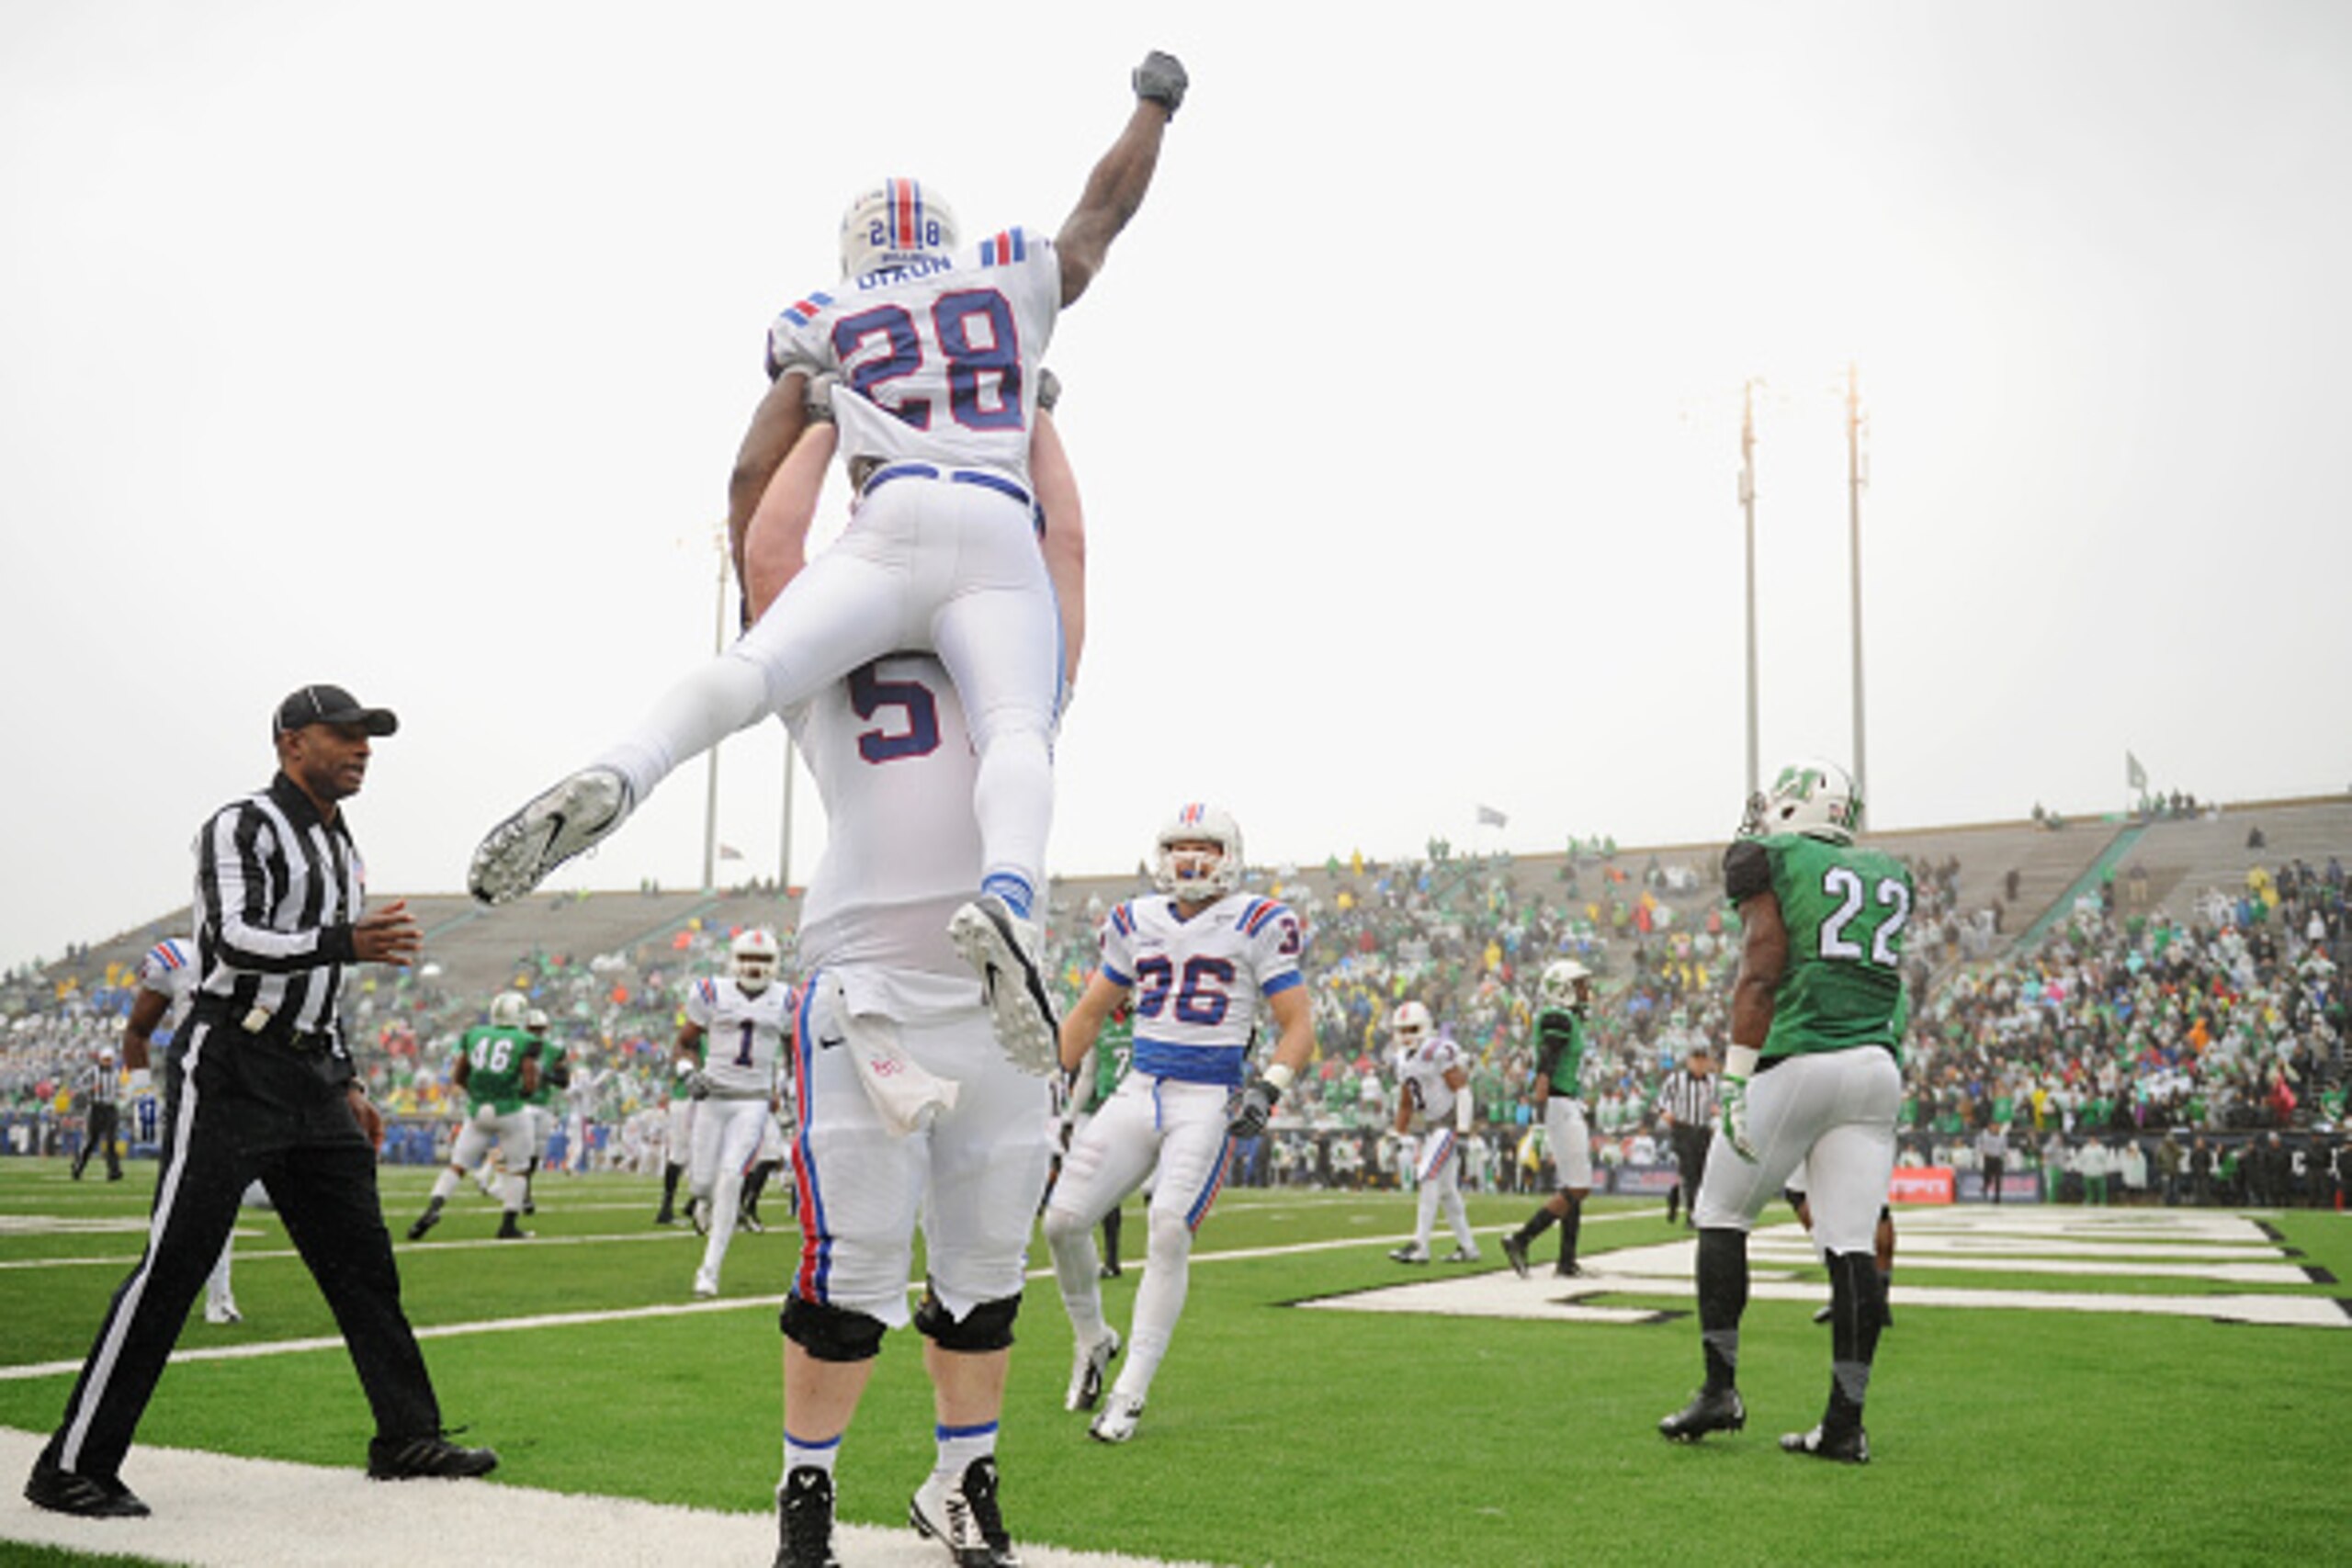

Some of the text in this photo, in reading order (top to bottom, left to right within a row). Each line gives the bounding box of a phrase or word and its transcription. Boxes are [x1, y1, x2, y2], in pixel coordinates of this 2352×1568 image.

[831, 288, 1023, 432] 28
[847, 653, 943, 764] 5
[1818, 864, 1911, 967] 22
[470, 1036, 513, 1073] 46
[733, 1017, 753, 1066] 1
